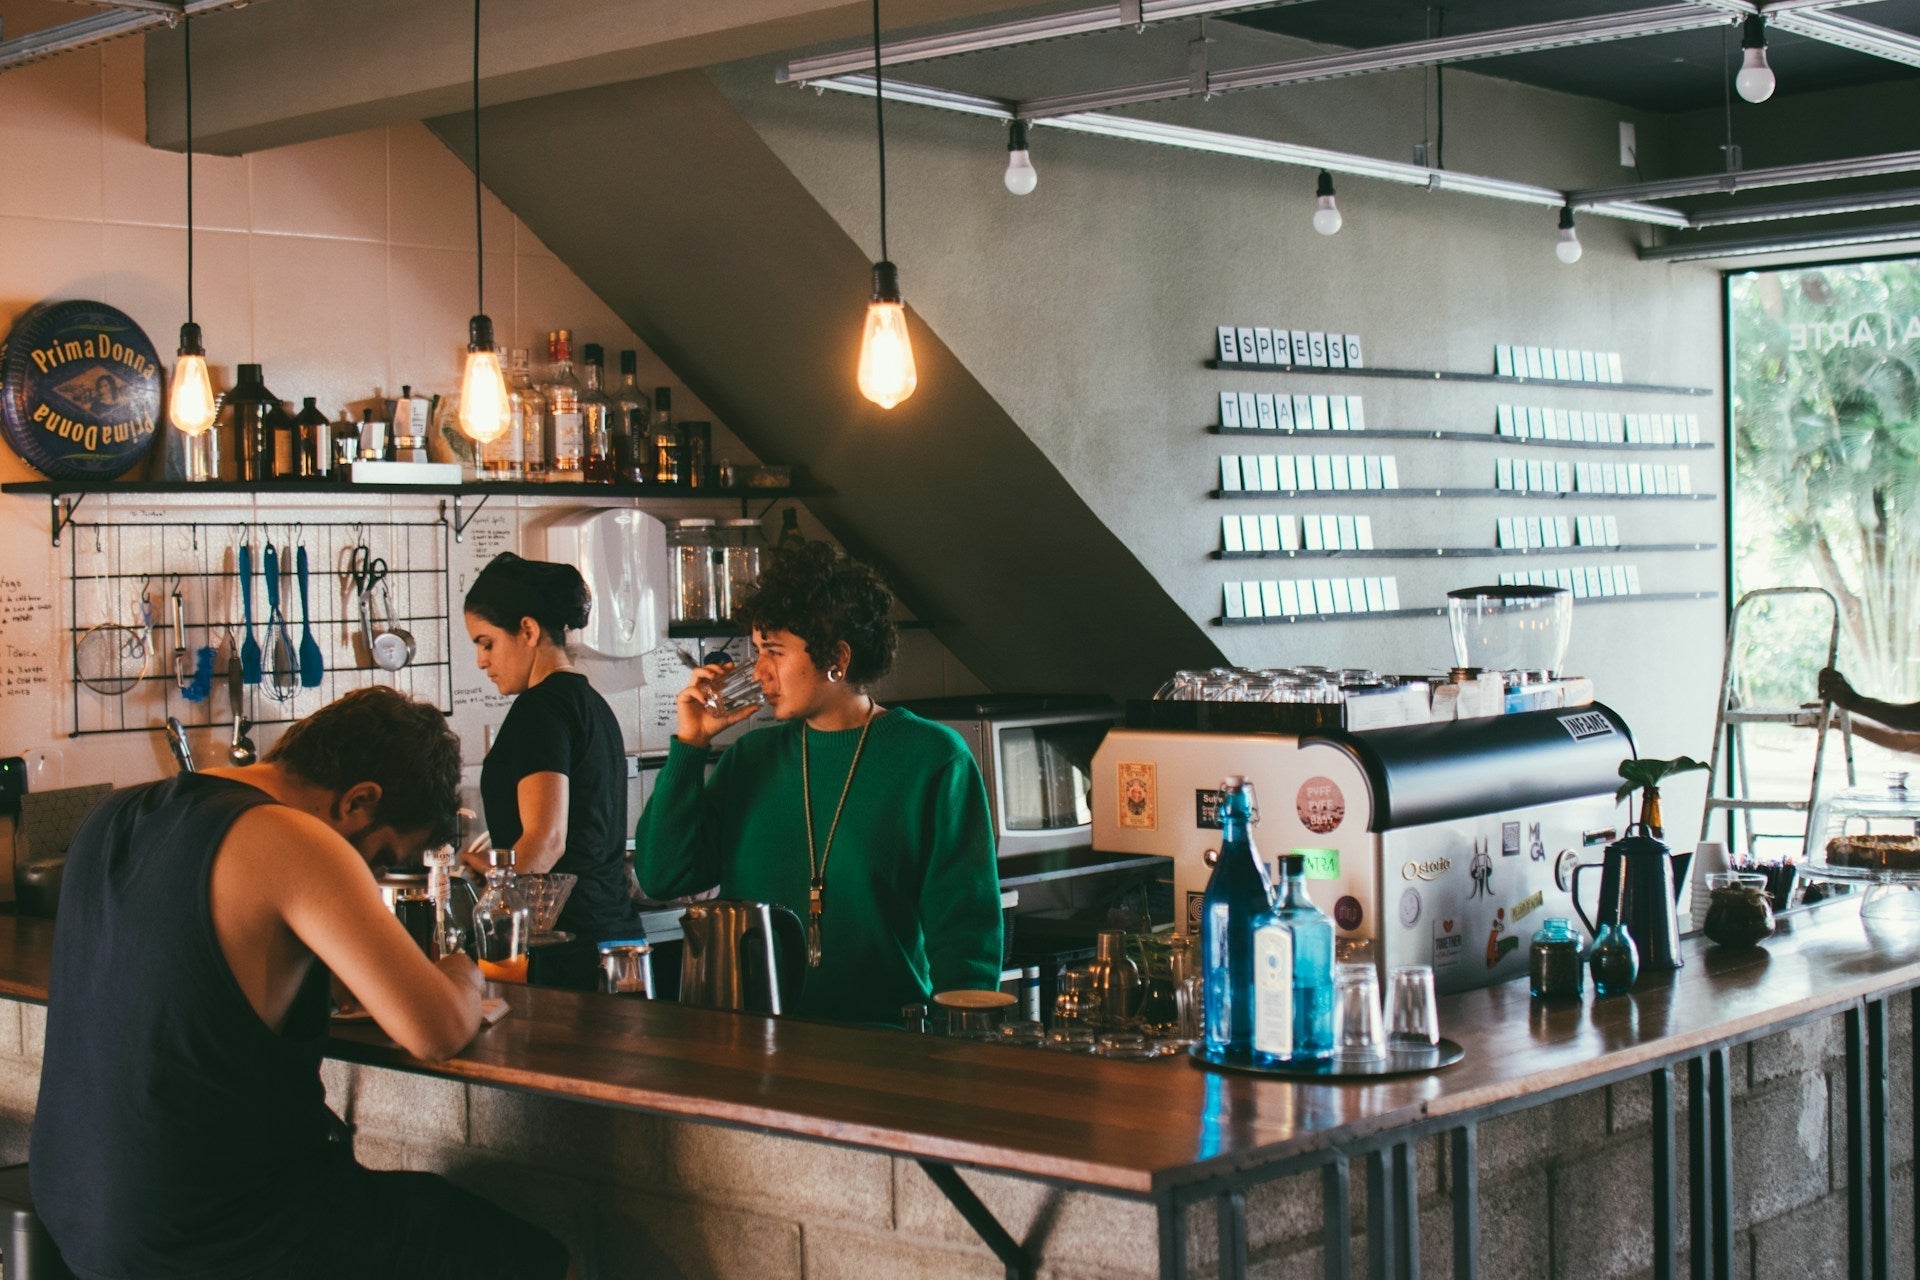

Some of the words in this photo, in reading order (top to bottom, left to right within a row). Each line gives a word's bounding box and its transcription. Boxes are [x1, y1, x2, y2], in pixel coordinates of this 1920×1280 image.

[31, 339, 95, 374] Prima
[98, 334, 156, 379] Donna
[1223, 334, 1360, 360] ESPRESSO
[33, 403, 98, 451] Donna
[101, 411, 156, 444] Prima
[1563, 713, 1610, 736] INFAME
